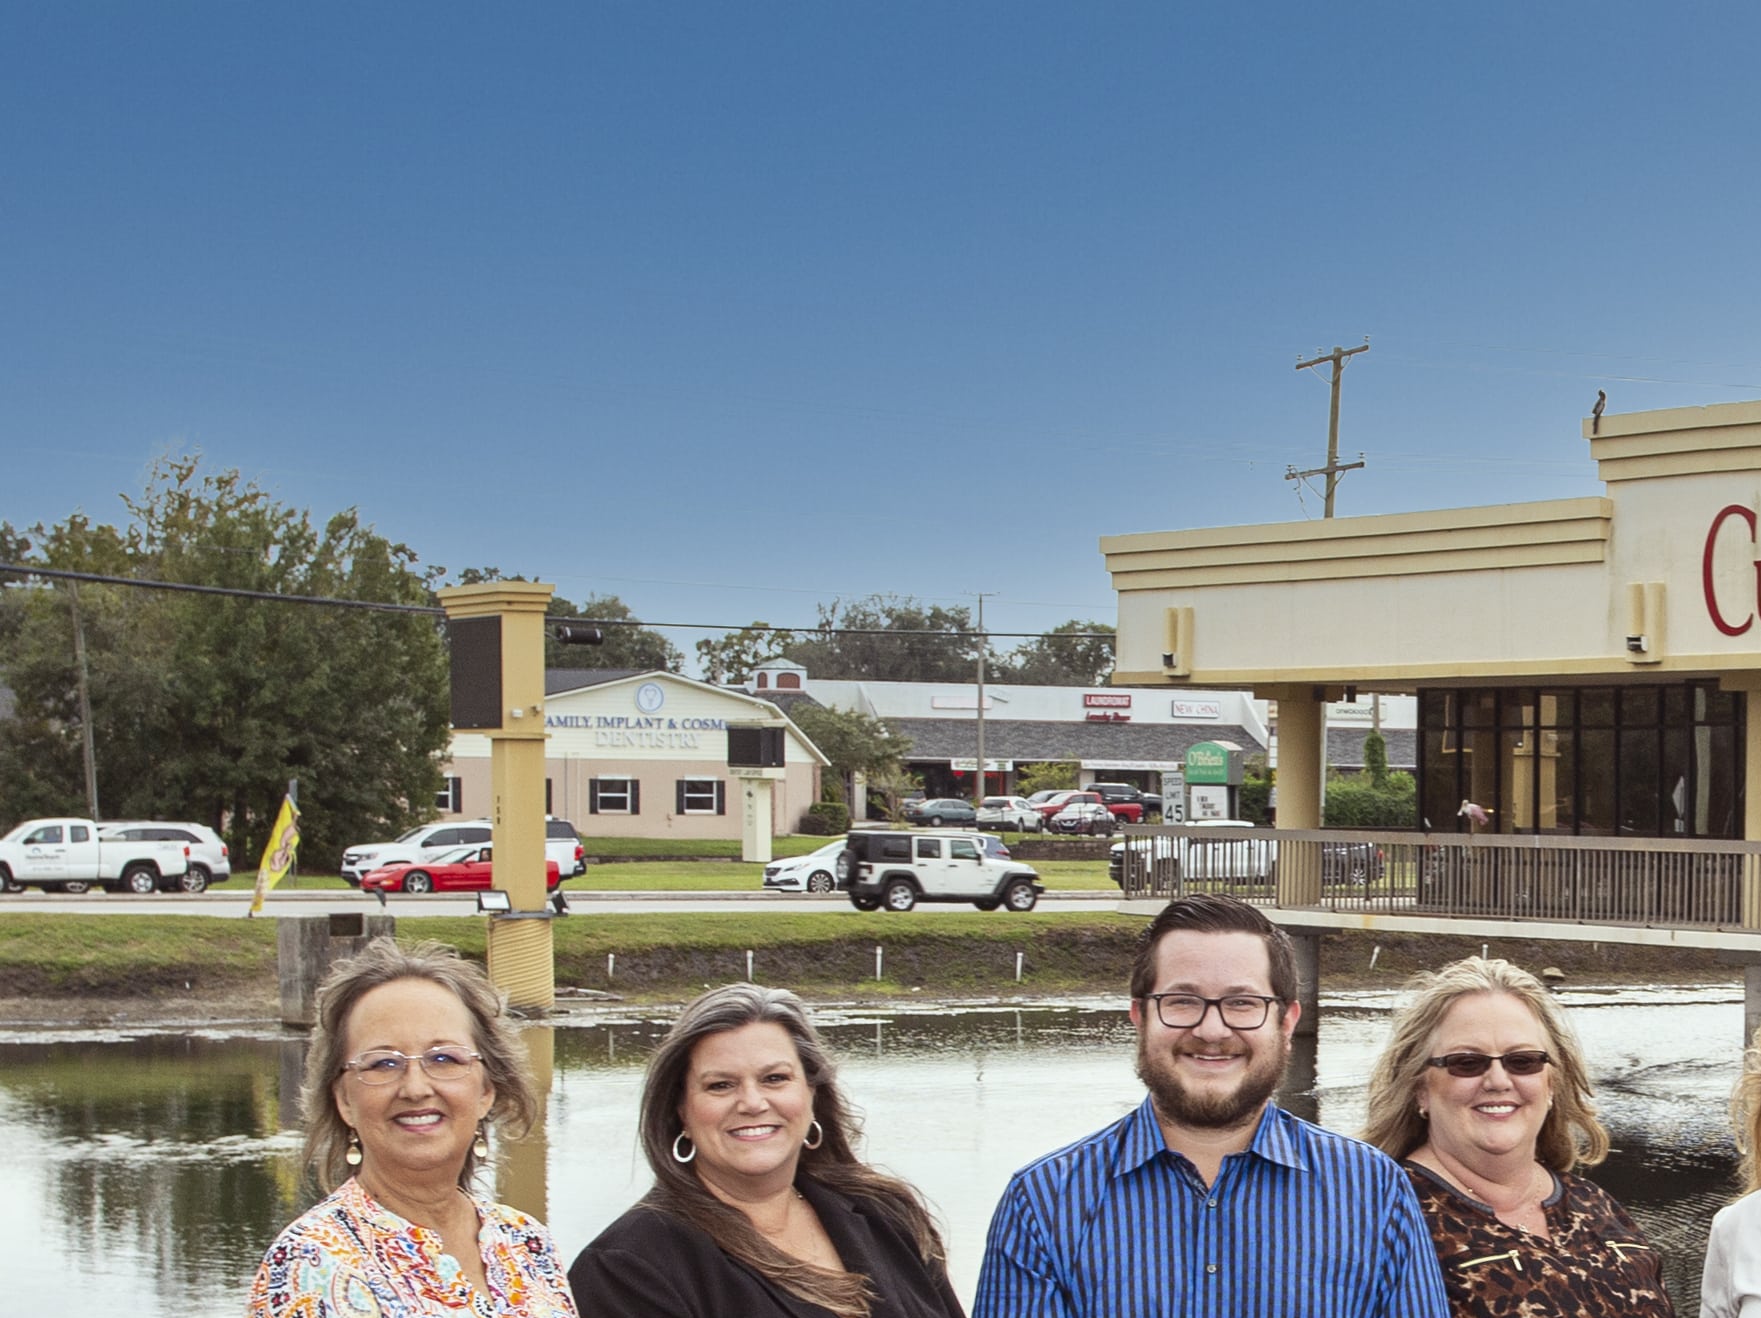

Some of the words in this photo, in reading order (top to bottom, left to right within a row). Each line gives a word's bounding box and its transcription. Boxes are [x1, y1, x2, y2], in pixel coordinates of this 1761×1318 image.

[596, 716, 665, 730] IMPLANT
[668, 718, 677, 730] &
[681, 718, 728, 731] COSM
[595, 731, 699, 749] DENTISTRY
[1163, 777, 1182, 786] SPEED
[1165, 791, 1180, 800] LIMIT
[1165, 804, 1183, 823] 45
